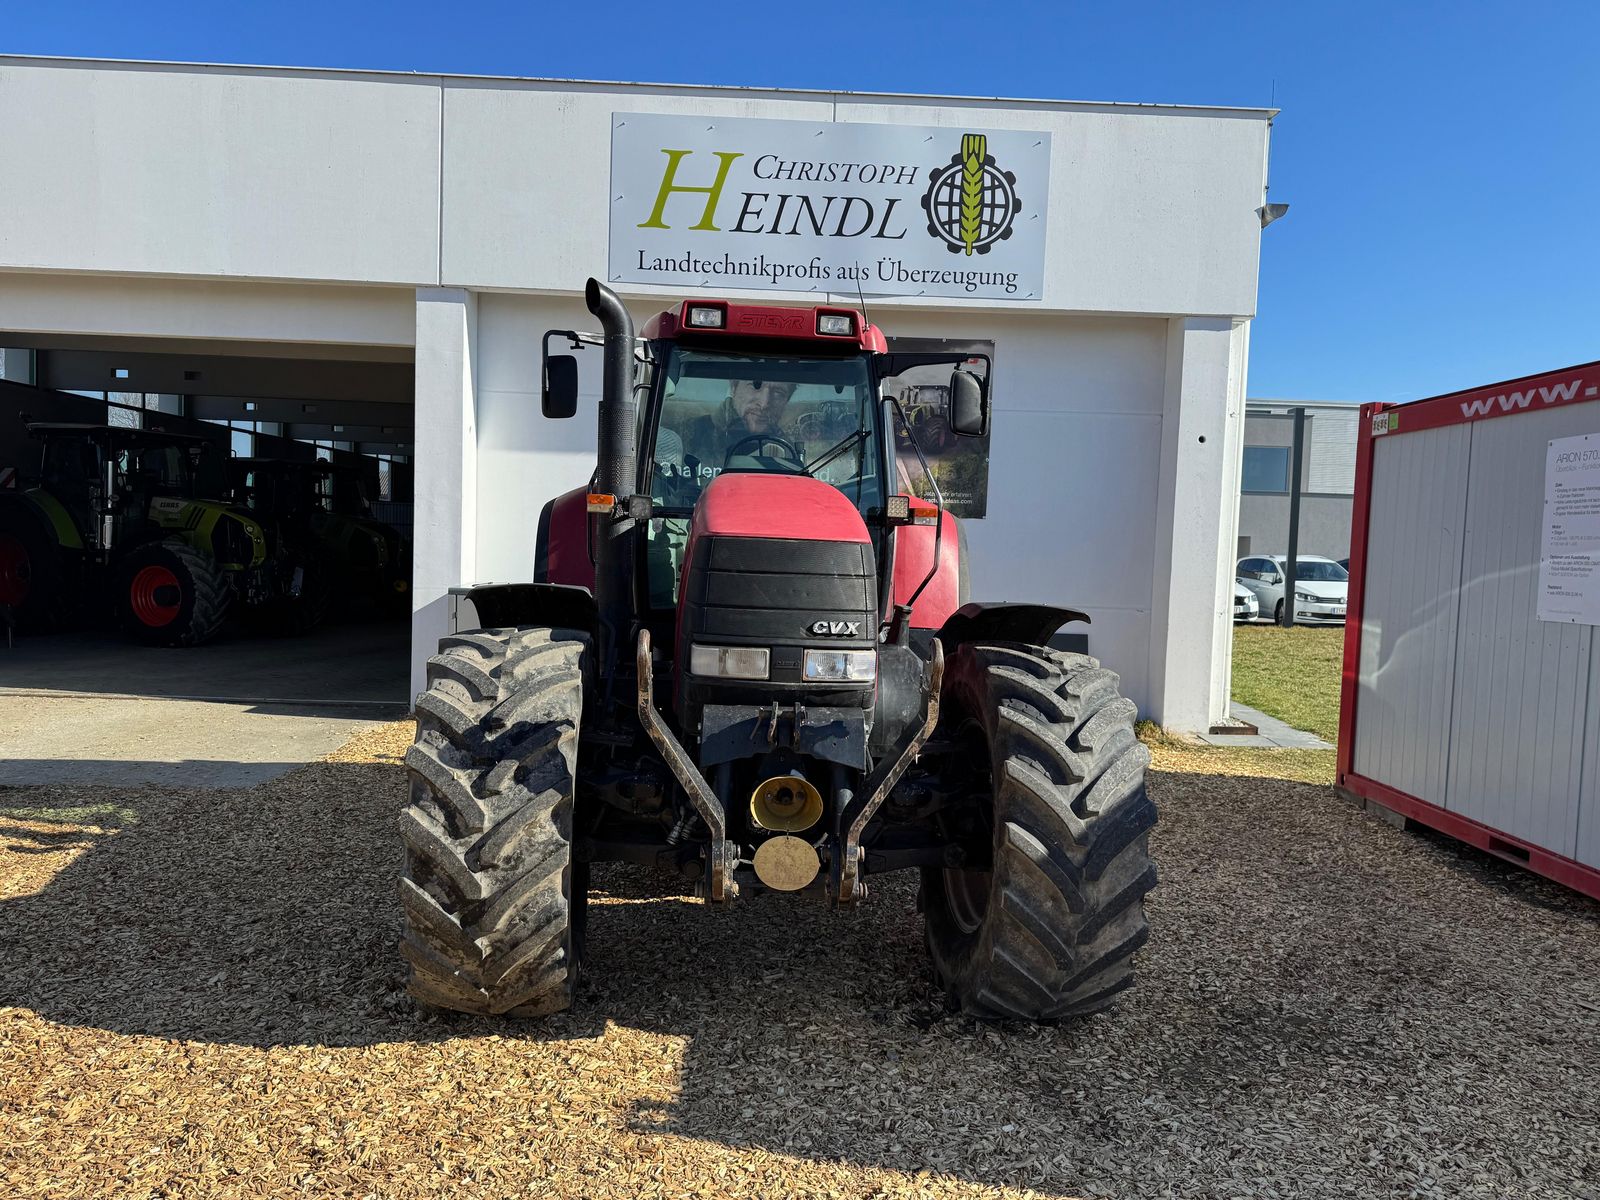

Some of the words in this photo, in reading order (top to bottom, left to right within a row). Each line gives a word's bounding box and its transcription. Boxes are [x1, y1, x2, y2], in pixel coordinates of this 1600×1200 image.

[752, 153, 920, 186] CHRISTOPH
[637, 249, 831, 284] Landtechnikprofis
[836, 264, 870, 281] aus
[876, 257, 1018, 293] Überzeugung
[736, 313, 805, 329] STEYR
[812, 621, 861, 635] CVX
